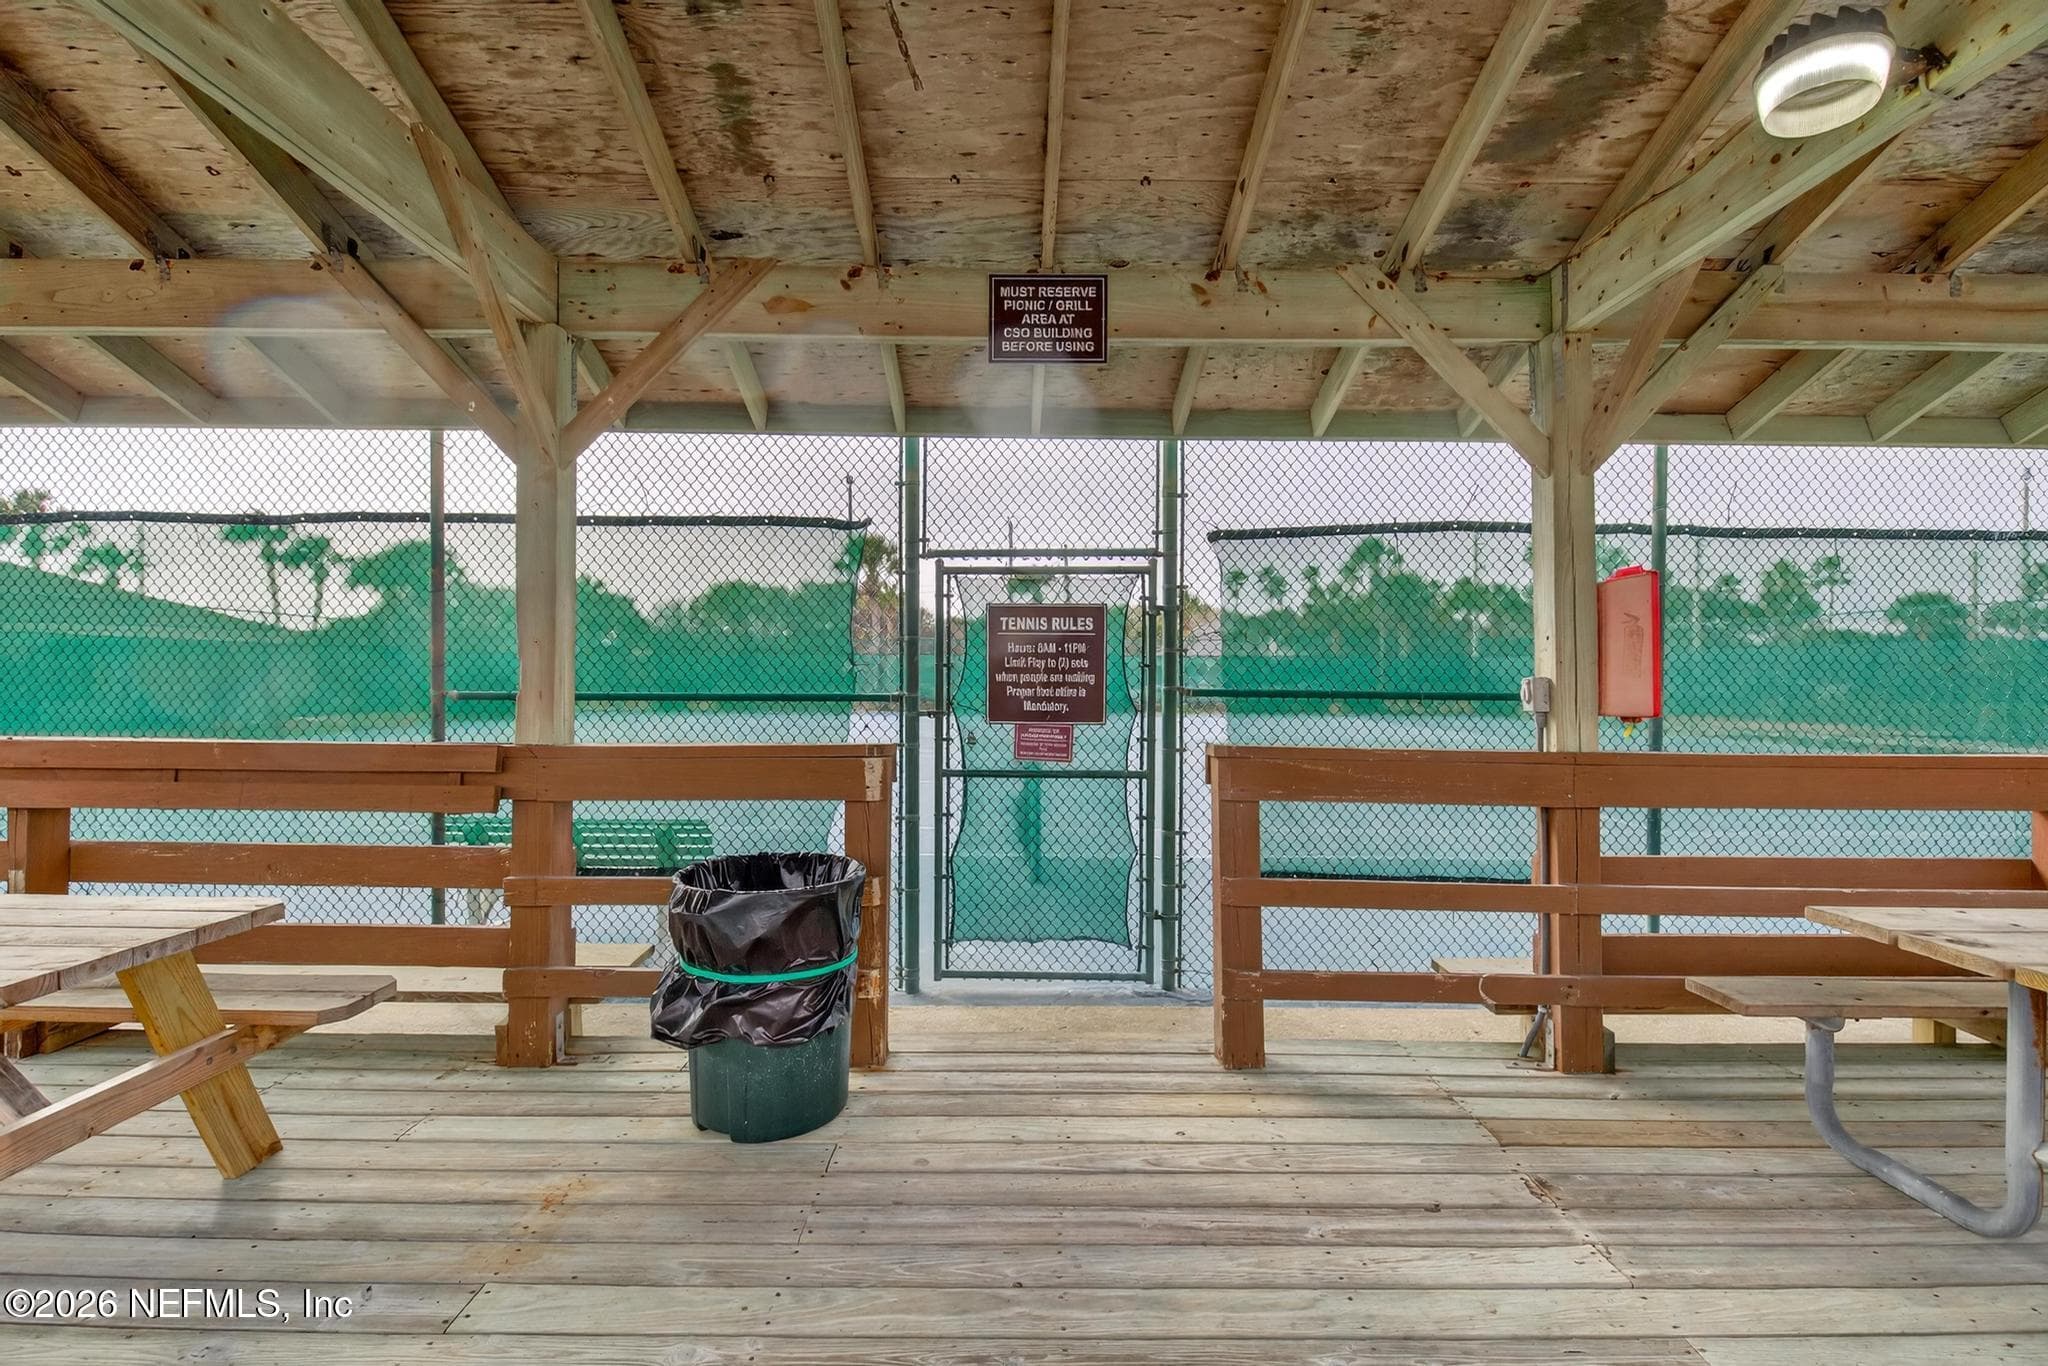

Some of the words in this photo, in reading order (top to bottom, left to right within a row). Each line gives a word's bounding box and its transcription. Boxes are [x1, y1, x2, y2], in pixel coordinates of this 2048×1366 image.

[1000, 286, 1035, 298] MUST
[1038, 286, 1097, 298] RESERVE
[1004, 300, 1045, 311] PICNIC
[1048, 300, 1053, 311] /
[1056, 300, 1093, 311] GRILL
[1021, 314, 1057, 325] AREA
[1058, 314, 1075, 325] AT
[1004, 327, 1030, 338] CSO
[1033, 327, 1093, 339] BUILDING
[1001, 341, 1053, 352] BEFORE
[1056, 341, 1095, 352] USING
[1000, 617, 1048, 631] TENNIS
[1051, 617, 1094, 631] RULES
[1007, 642, 1036, 653] Hours:
[1004, 656, 1026, 668] Limit
[1047, 657, 1057, 668] to
[1071, 657, 1089, 668] sets
[995, 671, 1018, 682] when
[1020, 671, 1048, 684] people
[1006, 685, 1035, 699] Proper
[1023, 700, 1070, 714] Mandatory.
